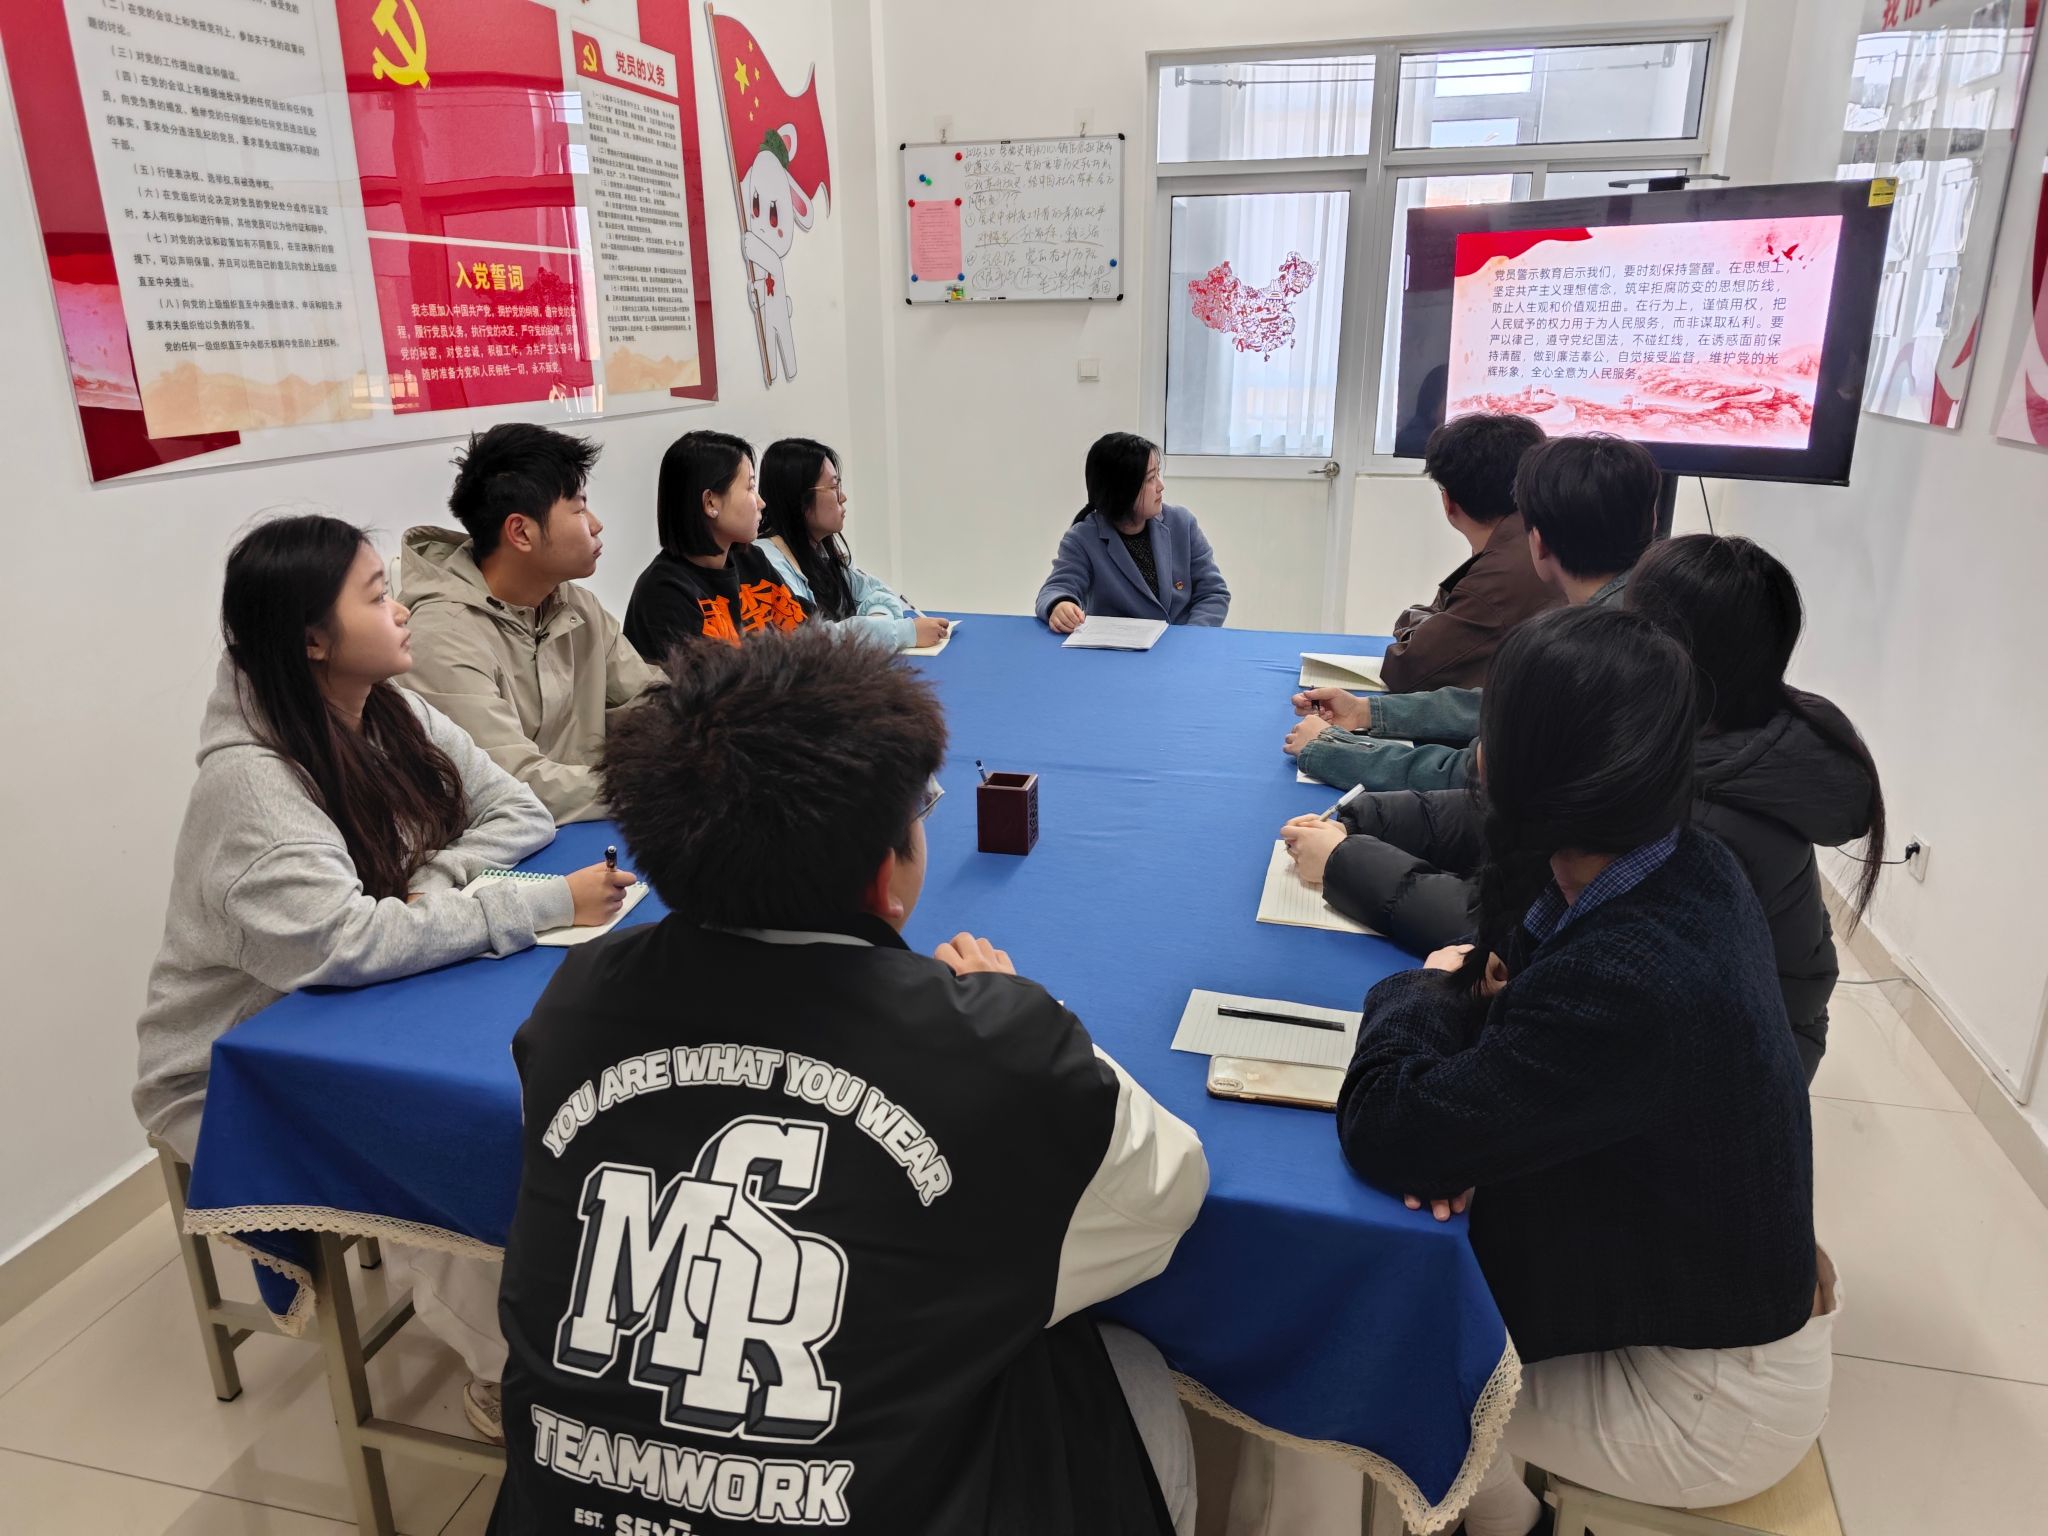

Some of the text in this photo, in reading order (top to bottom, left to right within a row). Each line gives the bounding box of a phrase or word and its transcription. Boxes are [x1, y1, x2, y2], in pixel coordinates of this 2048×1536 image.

[615, 50, 665, 87] 党员的义务
[455, 260, 525, 292] 入党誓词
[1494, 260, 1791, 282] 党员警示教育启示我们，要时刻保持警醒。在思想上，
[1493, 278, 1782, 298] 坚定共产主义理想信念，筑牢拒腐防变的思想防线，
[1492, 297, 1787, 314] 防止人生观和价值观扭曲。在行为上，谨慎用权，把
[1490, 315, 1785, 331] 人民赋予的权力用于为人民服务，而非谋取私利。要
[1489, 333, 1782, 347] 严以律己，遵守党纪国法，不碰红线，在诱惑面前保
[1488, 350, 1779, 366] 持清醒，做到廉洁奉公，自觉接受监督，维护党的光
[1487, 366, 1643, 381] 辉形象，全心全意为人民服务。
[543, 1044, 952, 1206] YOU ARE WHAT YOU WEAR
[531, 1404, 854, 1526] TEAMWORK
[574, 1507, 605, 1530] EST.
